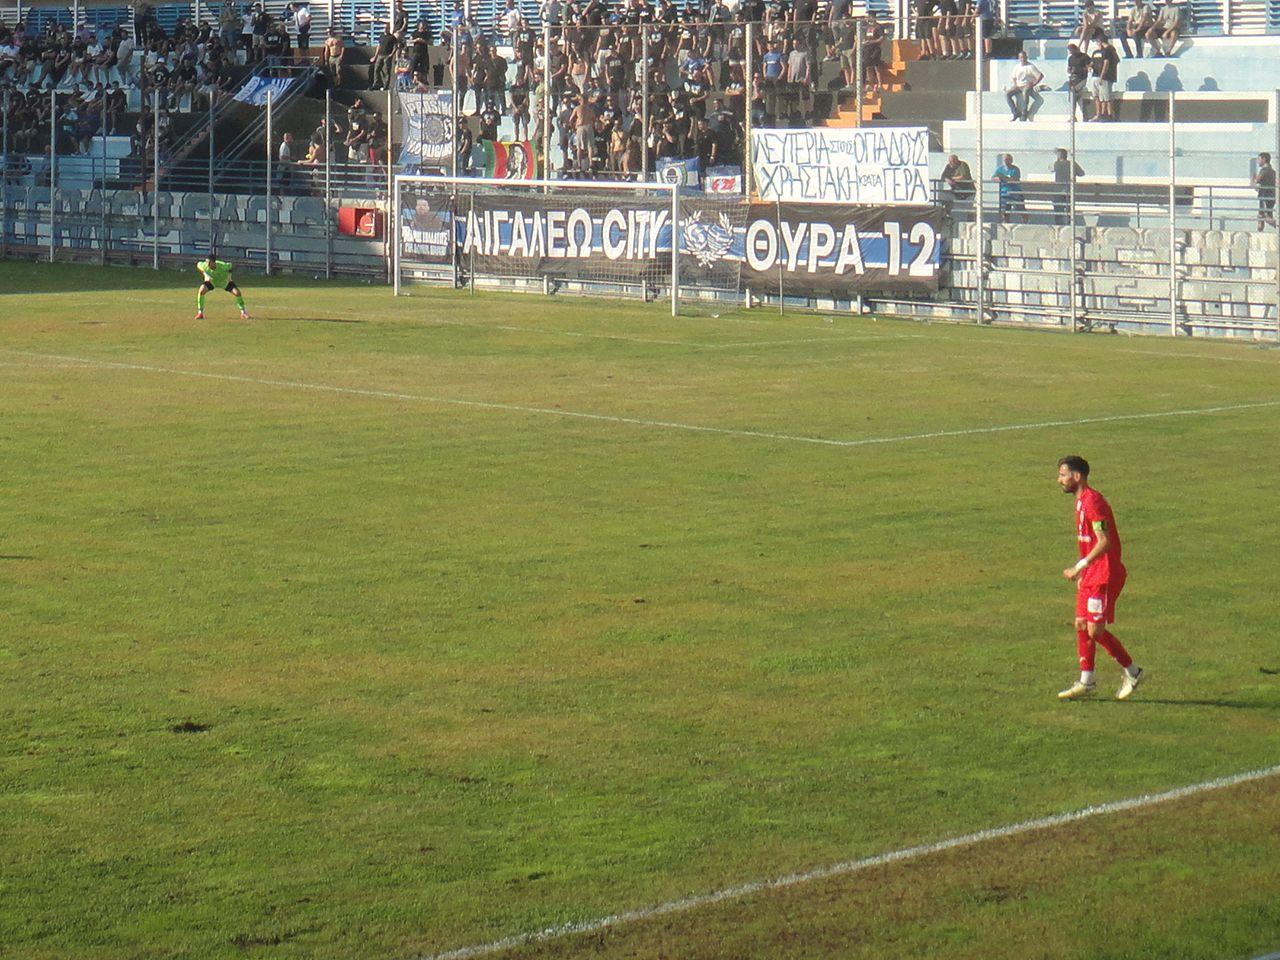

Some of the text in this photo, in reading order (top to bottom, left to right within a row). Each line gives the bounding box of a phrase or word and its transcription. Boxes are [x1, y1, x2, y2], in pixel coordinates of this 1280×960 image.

[854, 131, 928, 166] ΟΠΑΔΟΥΣ
[882, 167, 928, 201] ΓΕΡΑ
[464, 209, 669, 259] ΑΙΓΑΛΕΩ CITY
[746, 219, 935, 276] ΘΥΡΑ 12
